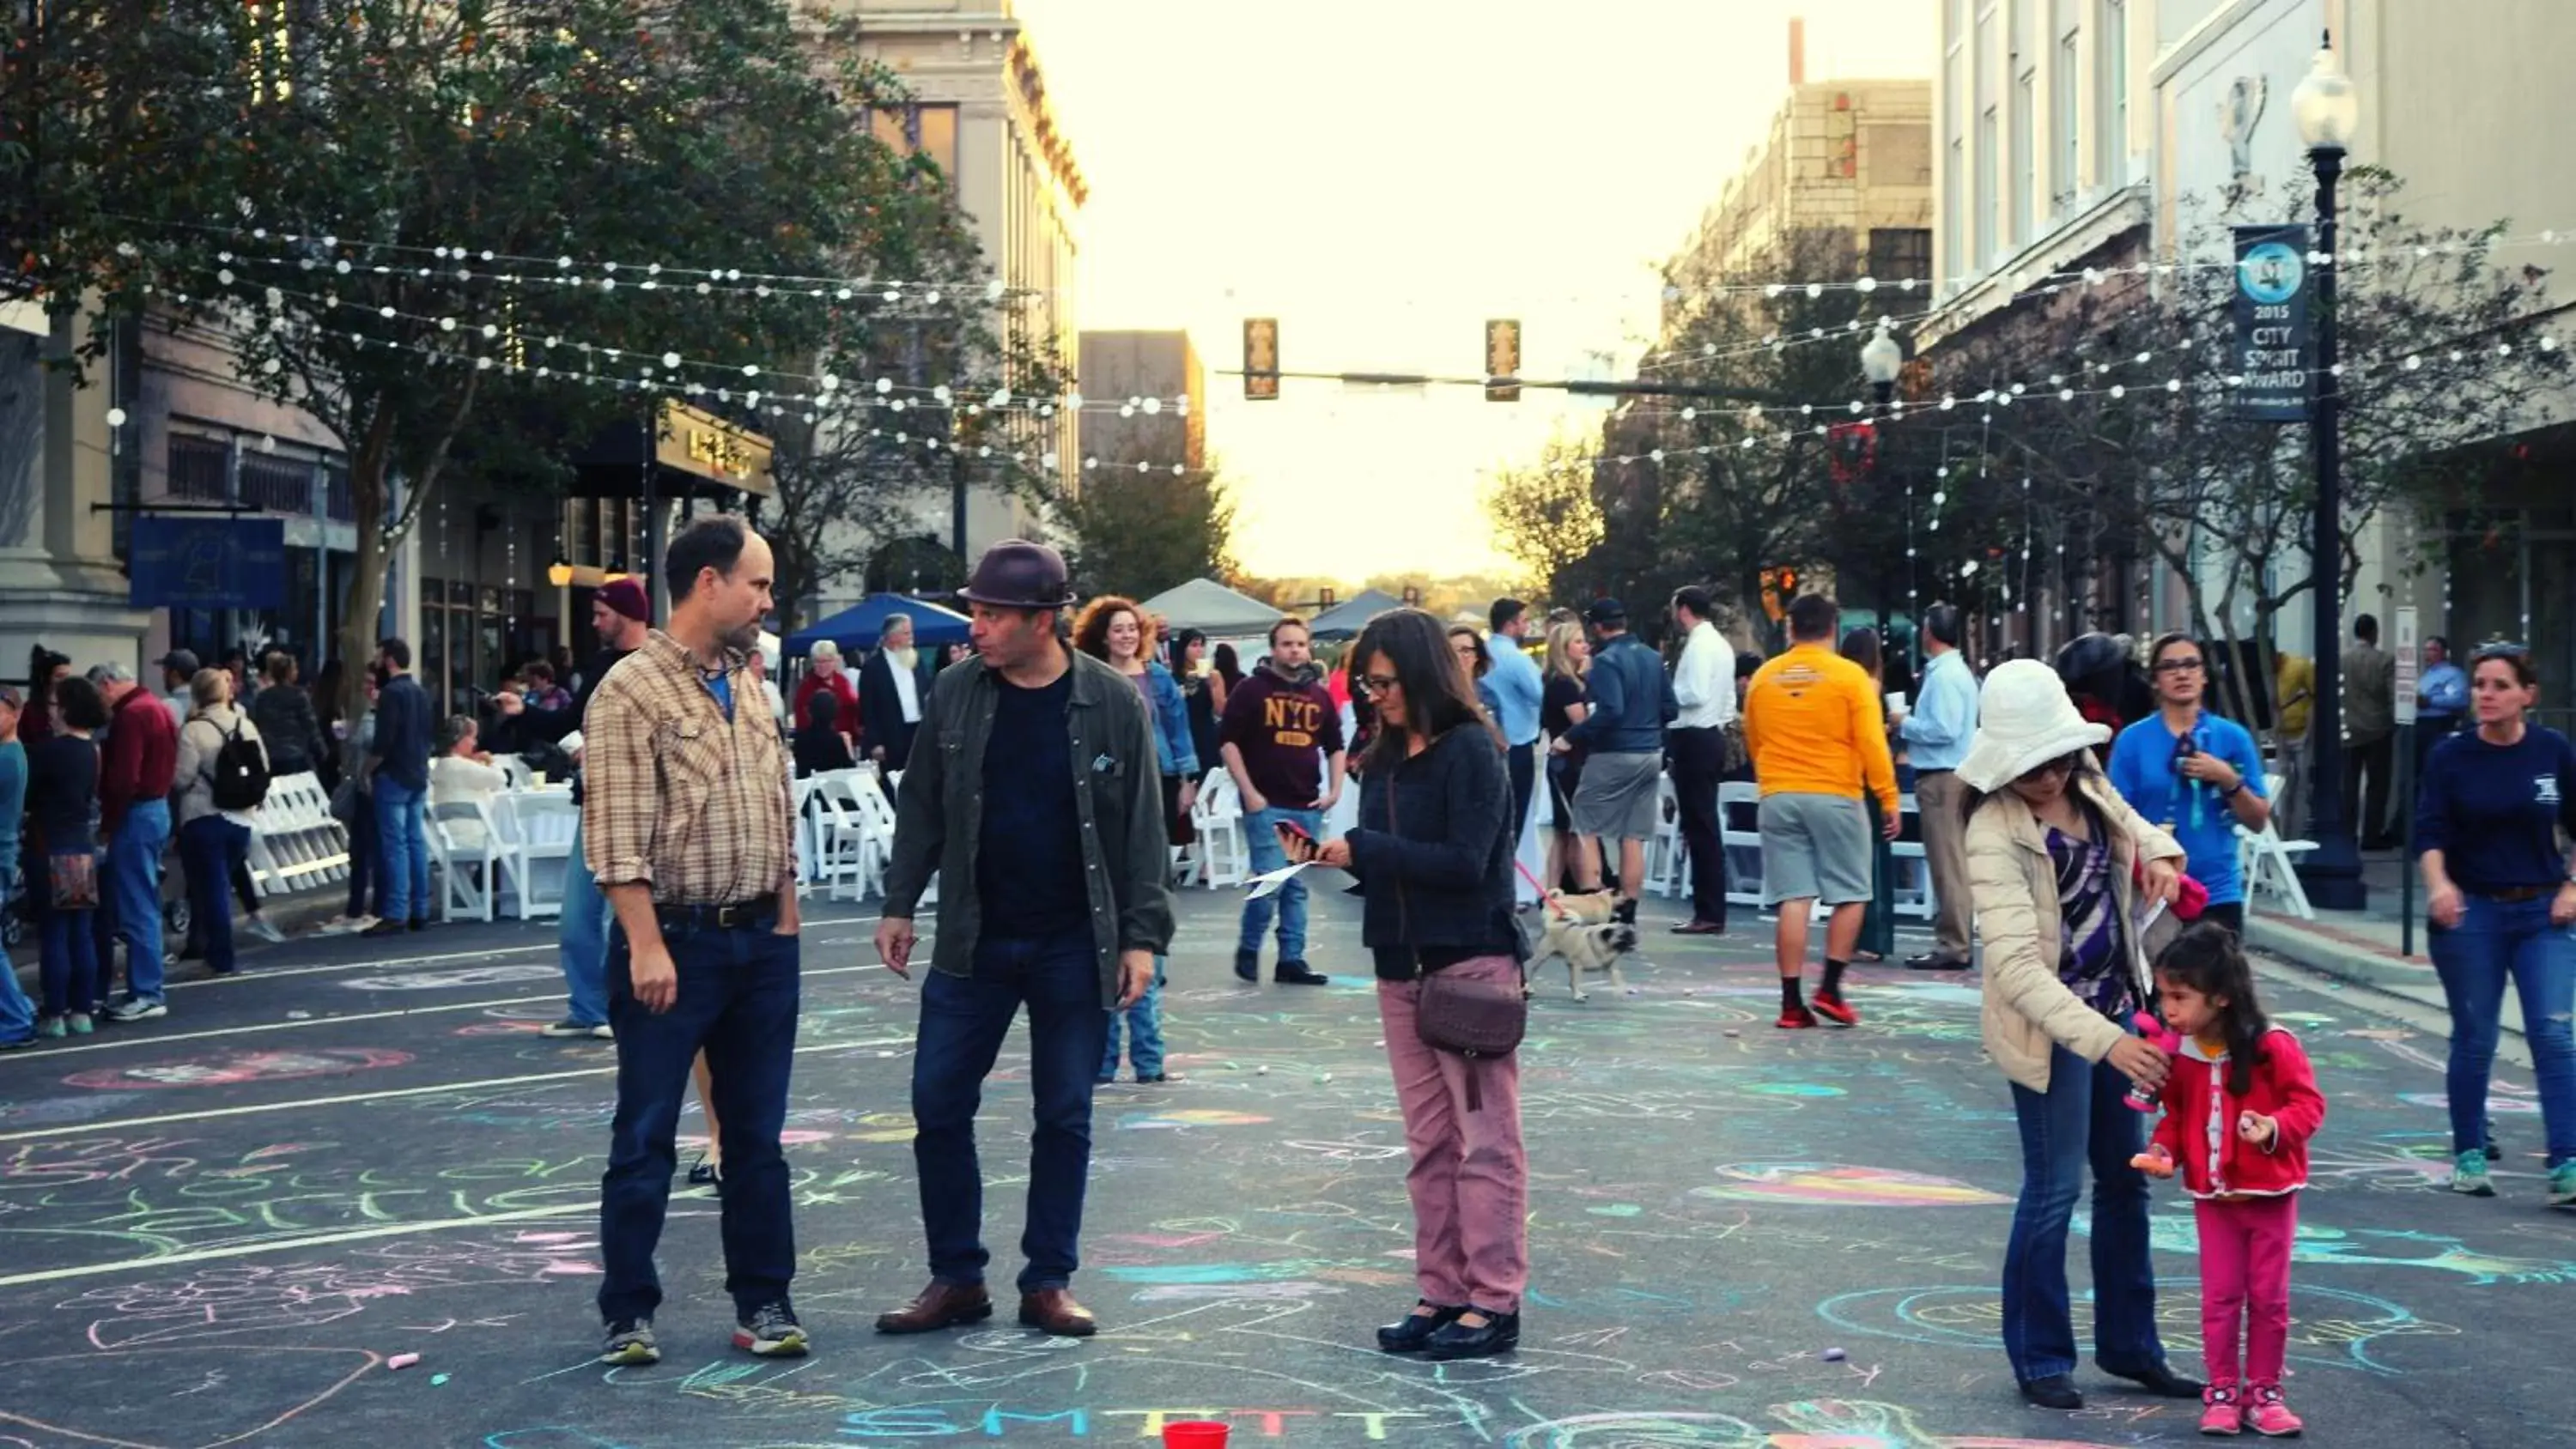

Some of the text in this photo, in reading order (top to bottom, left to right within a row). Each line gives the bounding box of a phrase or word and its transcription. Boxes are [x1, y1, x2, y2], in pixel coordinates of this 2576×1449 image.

[2254, 306, 2290, 319] 2015
[2251, 327, 2293, 345] CITY
[1264, 697, 1321, 731] NYC
